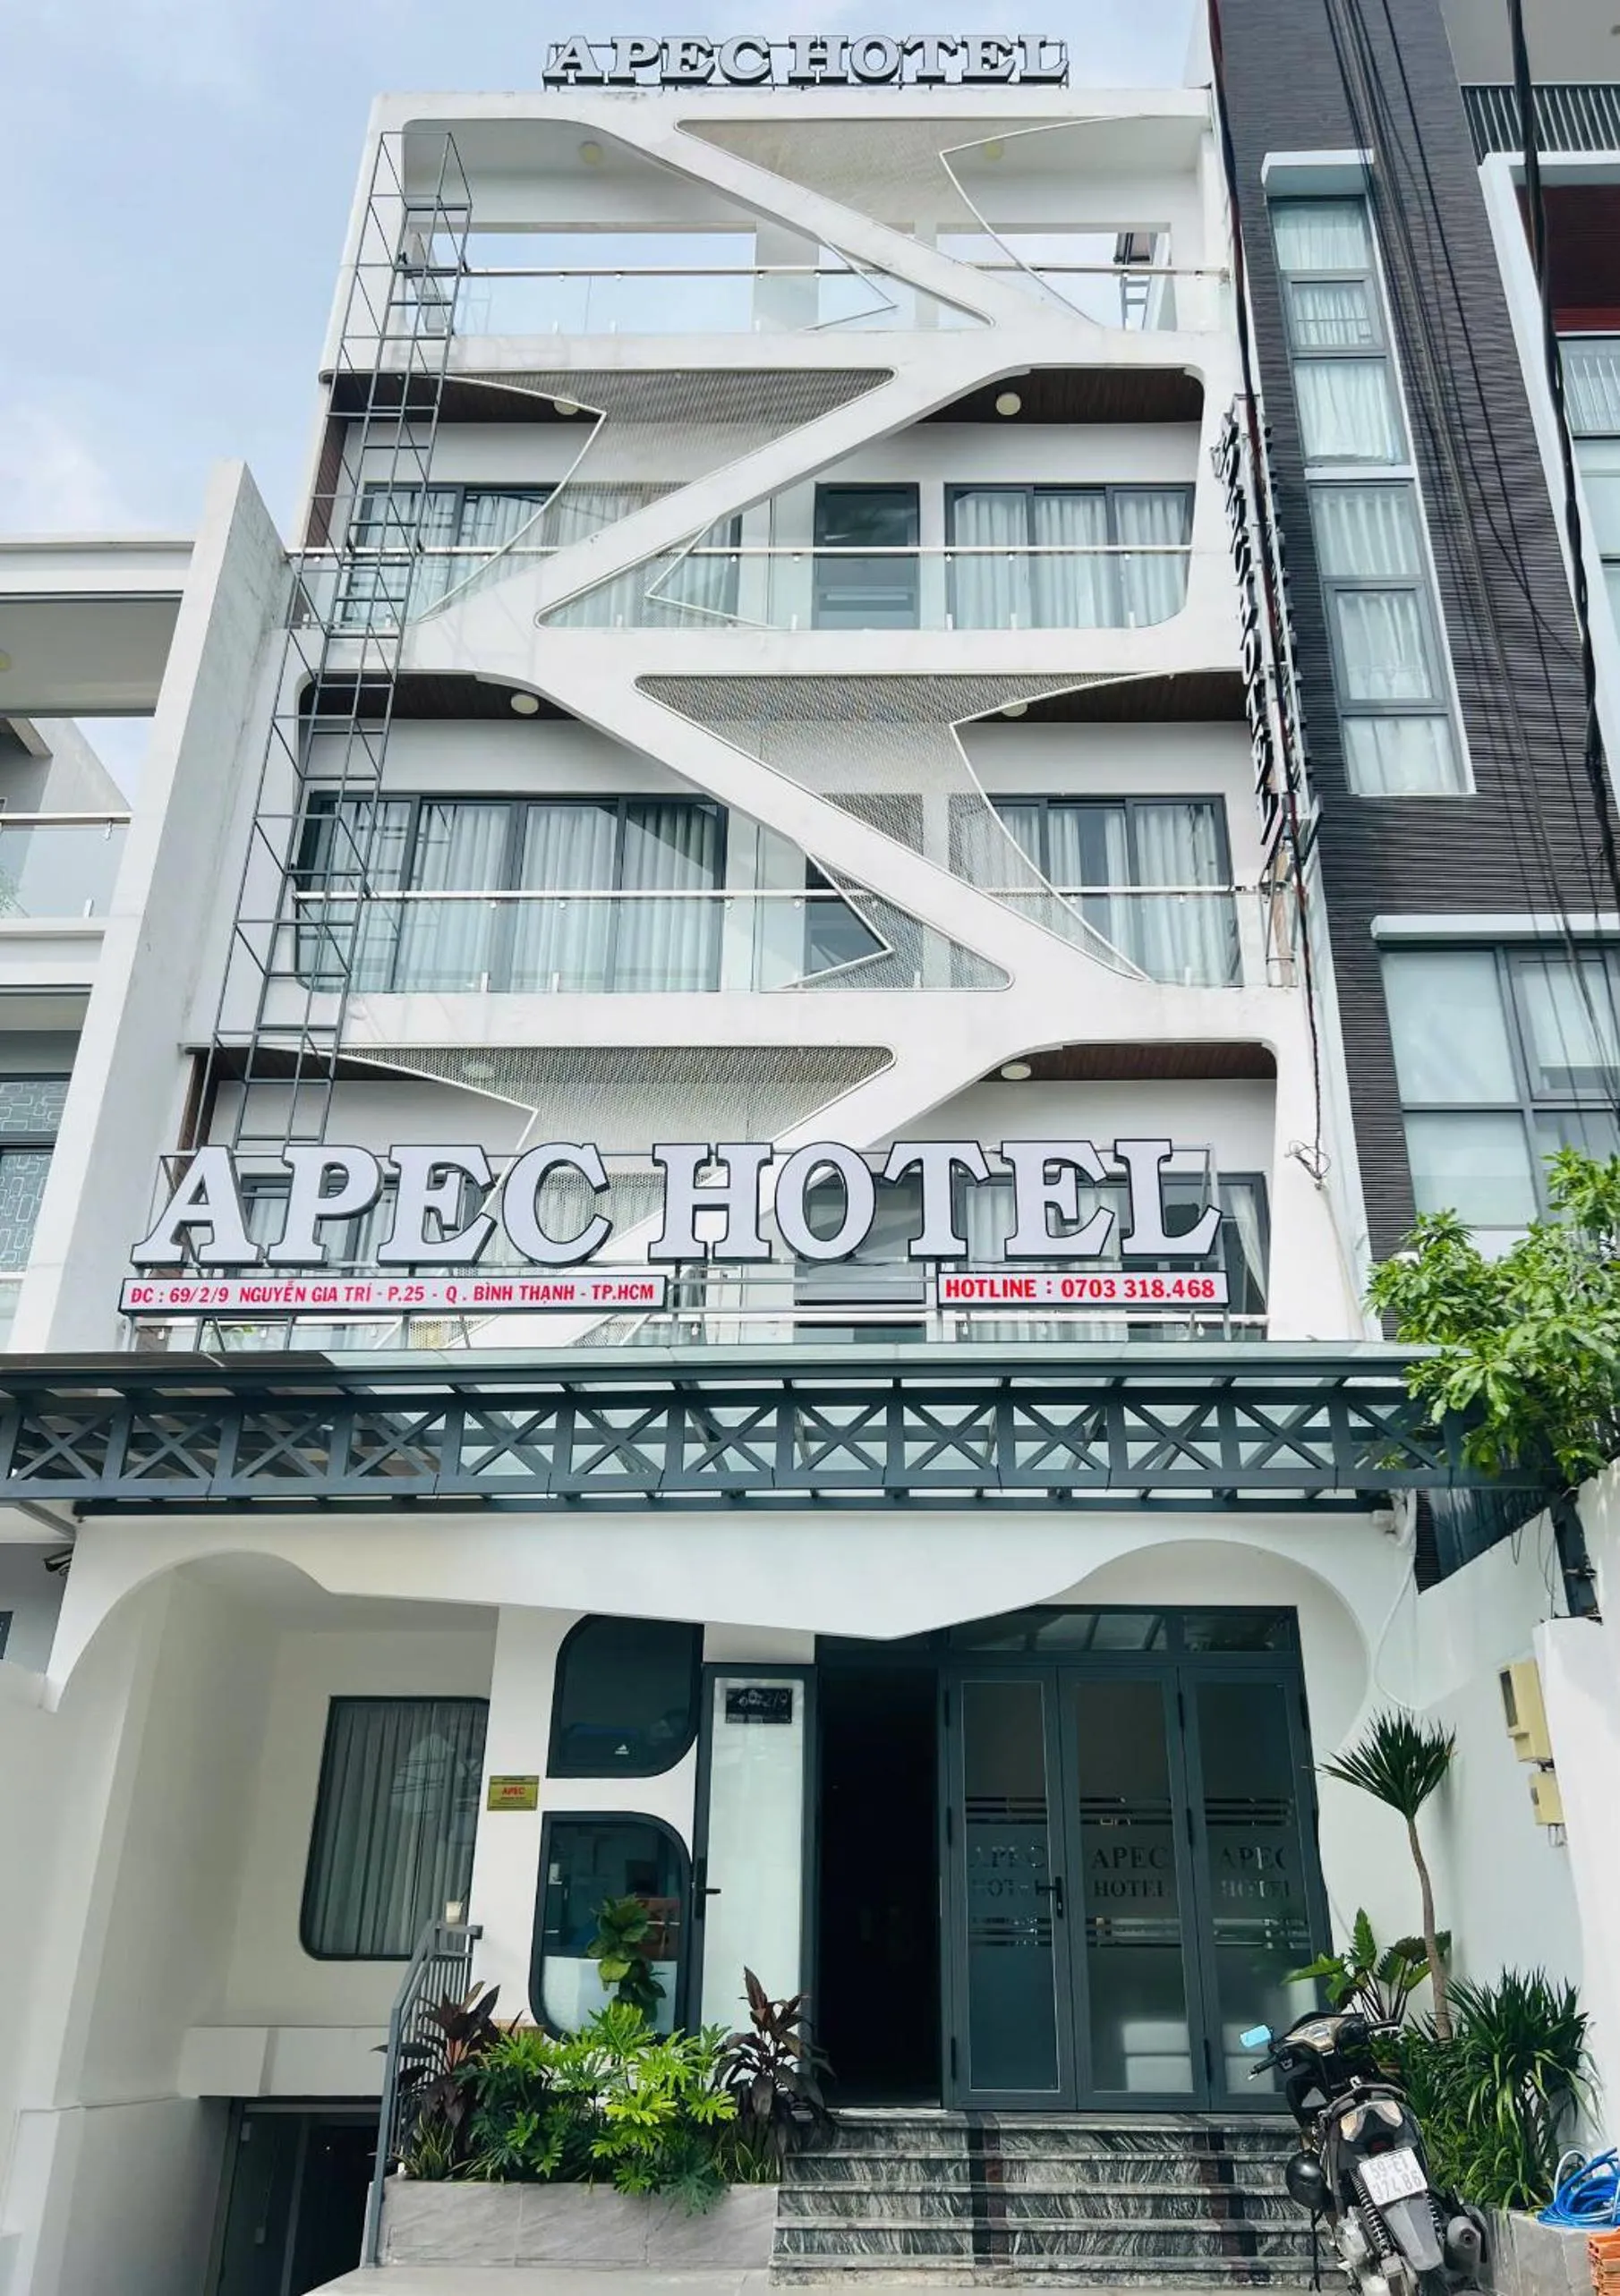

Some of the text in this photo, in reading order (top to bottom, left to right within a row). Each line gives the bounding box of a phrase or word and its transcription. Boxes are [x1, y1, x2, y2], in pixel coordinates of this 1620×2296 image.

[541, 35, 1069, 85] APEC HOTEL
[130, 1138, 1223, 1266] APEC HOTEL
[168, 1287, 229, 1304] 69/2/9
[239, 1280, 306, 1303] NGUYỄN
[311, 1287, 337, 1302] GIA
[345, 1282, 371, 1302] TRÍ
[387, 1285, 425, 1303] P.25
[473, 1281, 513, 1301] BÌNH
[519, 1284, 575, 1304] THẠNH
[592, 1283, 655, 1301] TP.HCM
[945, 1278, 1037, 1298] HOTLINE
[1061, 1279, 1116, 1298] 0703
[1123, 1278, 1216, 1298] 318.468
[1091, 1846, 1168, 1868] APEC
